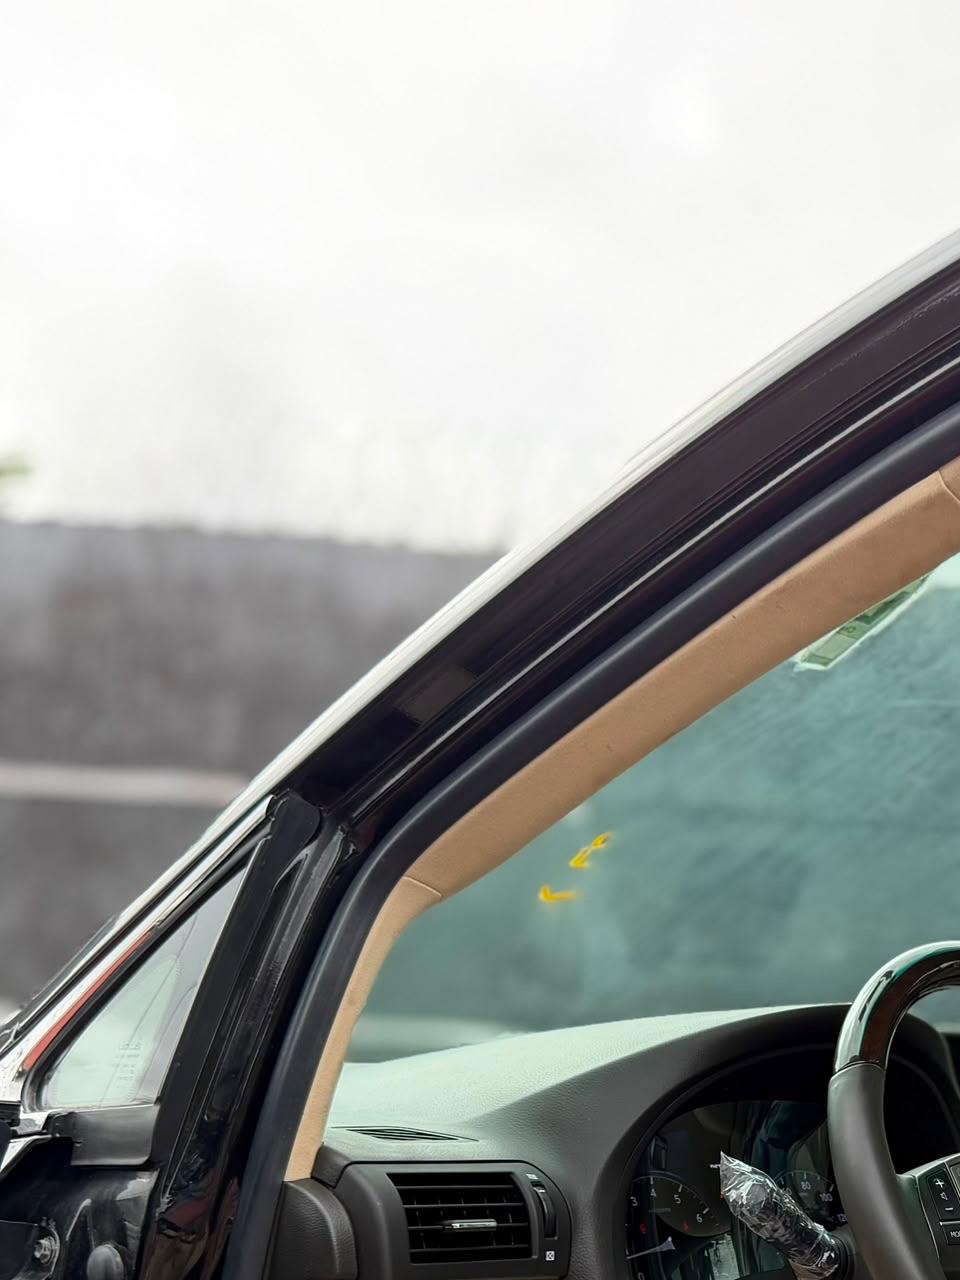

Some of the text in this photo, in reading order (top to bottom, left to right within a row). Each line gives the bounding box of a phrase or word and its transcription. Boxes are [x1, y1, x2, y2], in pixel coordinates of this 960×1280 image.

[630, 1197, 638, 1207] 3
[674, 1195, 682, 1204] 5
[695, 1214, 703, 1224] 6
